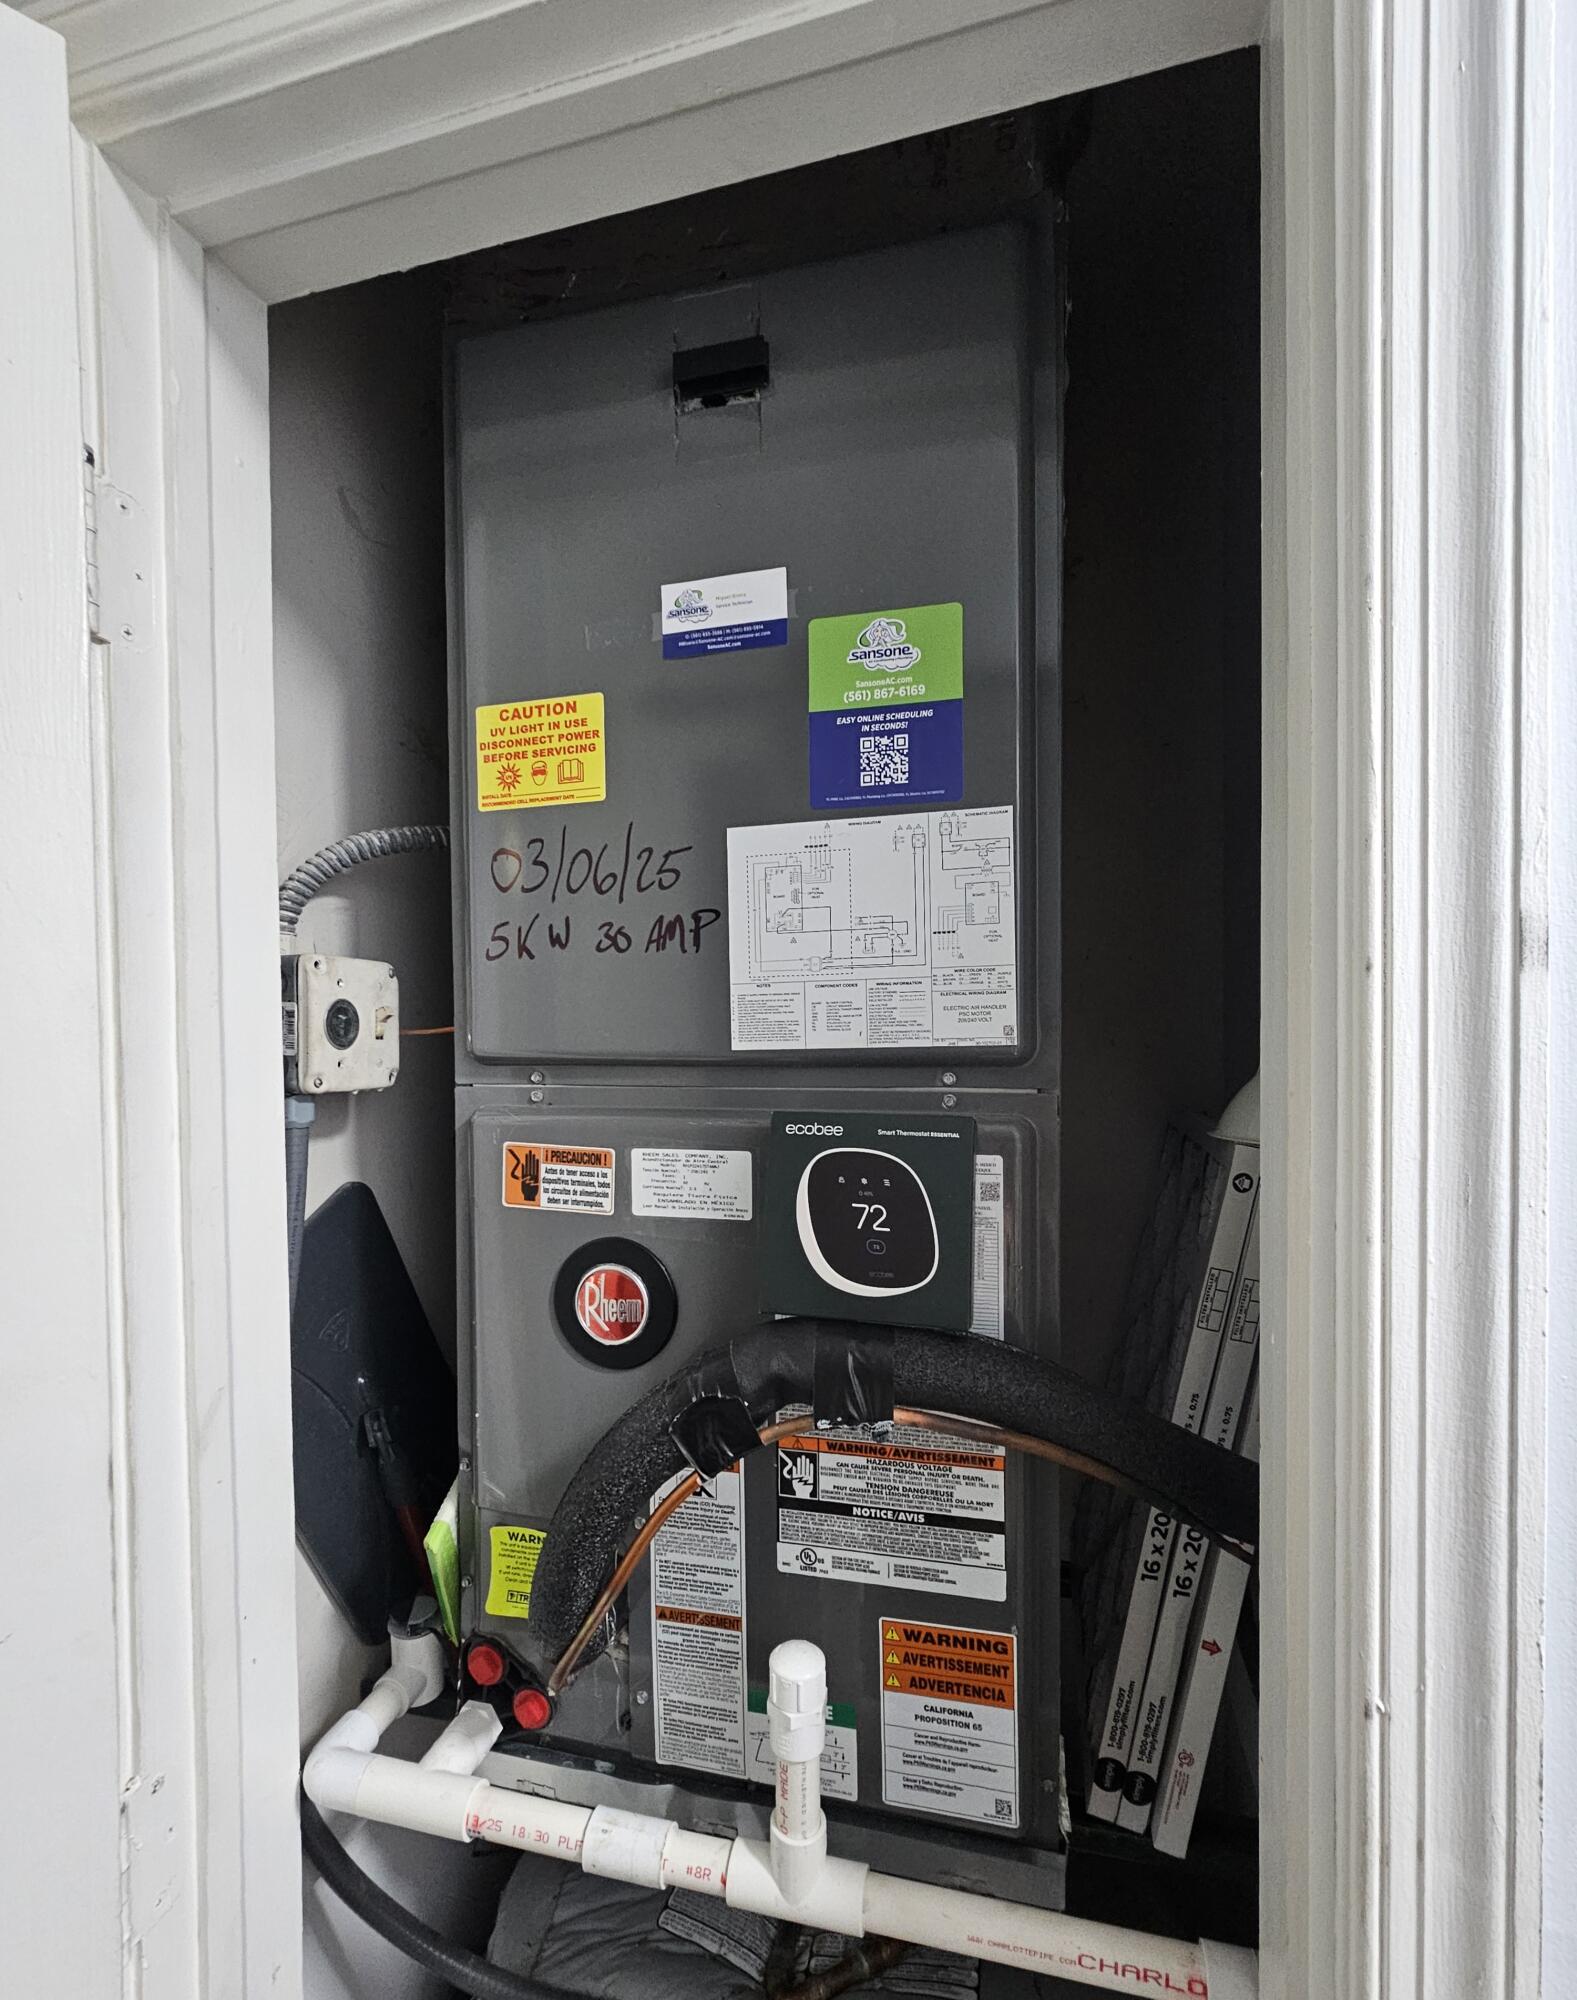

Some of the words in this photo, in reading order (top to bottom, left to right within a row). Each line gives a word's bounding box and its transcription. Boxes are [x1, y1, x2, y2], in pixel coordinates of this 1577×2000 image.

[668, 605, 709, 618] sansone
[849, 645, 913, 661] sansone
[855, 676, 913, 688] SansoneAC.com
[843, 690, 871, 703] (561)
[873, 684, 926, 700] 867-6169
[499, 701, 577, 722] CAUTION
[836, 716, 856, 725] EASY
[856, 713, 885, 723] ONLINE
[885, 709, 934, 721] SCHEDULING
[490, 728, 506, 737] UV
[509, 723, 545, 735] LIGHT
[548, 721, 561, 731] IN
[564, 718, 588, 728] USE
[861, 725, 870, 733] IN
[870, 721, 909, 732] SECONDS!
[480, 735, 554, 751] DISCONNECT
[558, 729, 600, 743] POWER
[483, 750, 529, 764] BEFORE
[532, 743, 597, 758] SERVICING
[490, 821, 693, 904] 03/06/25
[595, 921, 632, 953] 30
[645, 908, 722, 954] AMP
[785, 1122, 844, 1136] ecobee
[896, 1129, 930, 1137] Thermostat
[930, 1131, 960, 1139] ESSENTIAL
[545, 1167, 558, 1175] Antes
[597, 1181, 611, 1189] todos
[851, 1203, 891, 1232] 72
[584, 1273, 641, 1332] Rheem
[1189, 1393, 1200, 1412] 0.75
[1222, 1405, 1234, 1425] 0.75
[826, 1441, 997, 1467] WARNING/AVERTISSEMENT
[866, 1458, 915, 1469] HAZARDOUS
[917, 1463, 953, 1473] VOLTAGE
[871, 1465, 892, 1473] SEVERE
[893, 1468, 926, 1477] PERSONAL
[927, 1472, 950, 1480] INJURY
[848, 1486, 871, 1494] CAUSER
[911, 1493, 954, 1503] CORPORELLES
[865, 1482, 900, 1493] TENSION
[902, 1486, 955, 1498] DANGEREUSE
[852, 1506, 926, 1524] NOTICE/AVIS
[1152, 1511, 1172, 1538] 20
[1185, 1527, 1205, 1554] 20
[1150, 1543, 1164, 1557] x
[800, 1565, 817, 1573] LISTED
[1141, 1558, 1161, 1583] 16
[1184, 1558, 1198, 1573] x
[1173, 1573, 1194, 1600] 16
[902, 1628, 1009, 1656] WARNING
[902, 1651, 1010, 1679] AVERTISSEMENT
[909, 1676, 1007, 1703] ADVERTENCIA
[923, 1704, 974, 1719] CALIFORNIA
[1116, 1680, 1136, 1752] simplyfilters.com
[914, 1714, 971, 1730] PROPOSITION
[972, 1723, 983, 1731] 65
[1145, 1695, 1167, 1765] simplyfilters.com
[902, 1752, 918, 1760] Cancer
[686, 1864, 712, 1882] #8R
